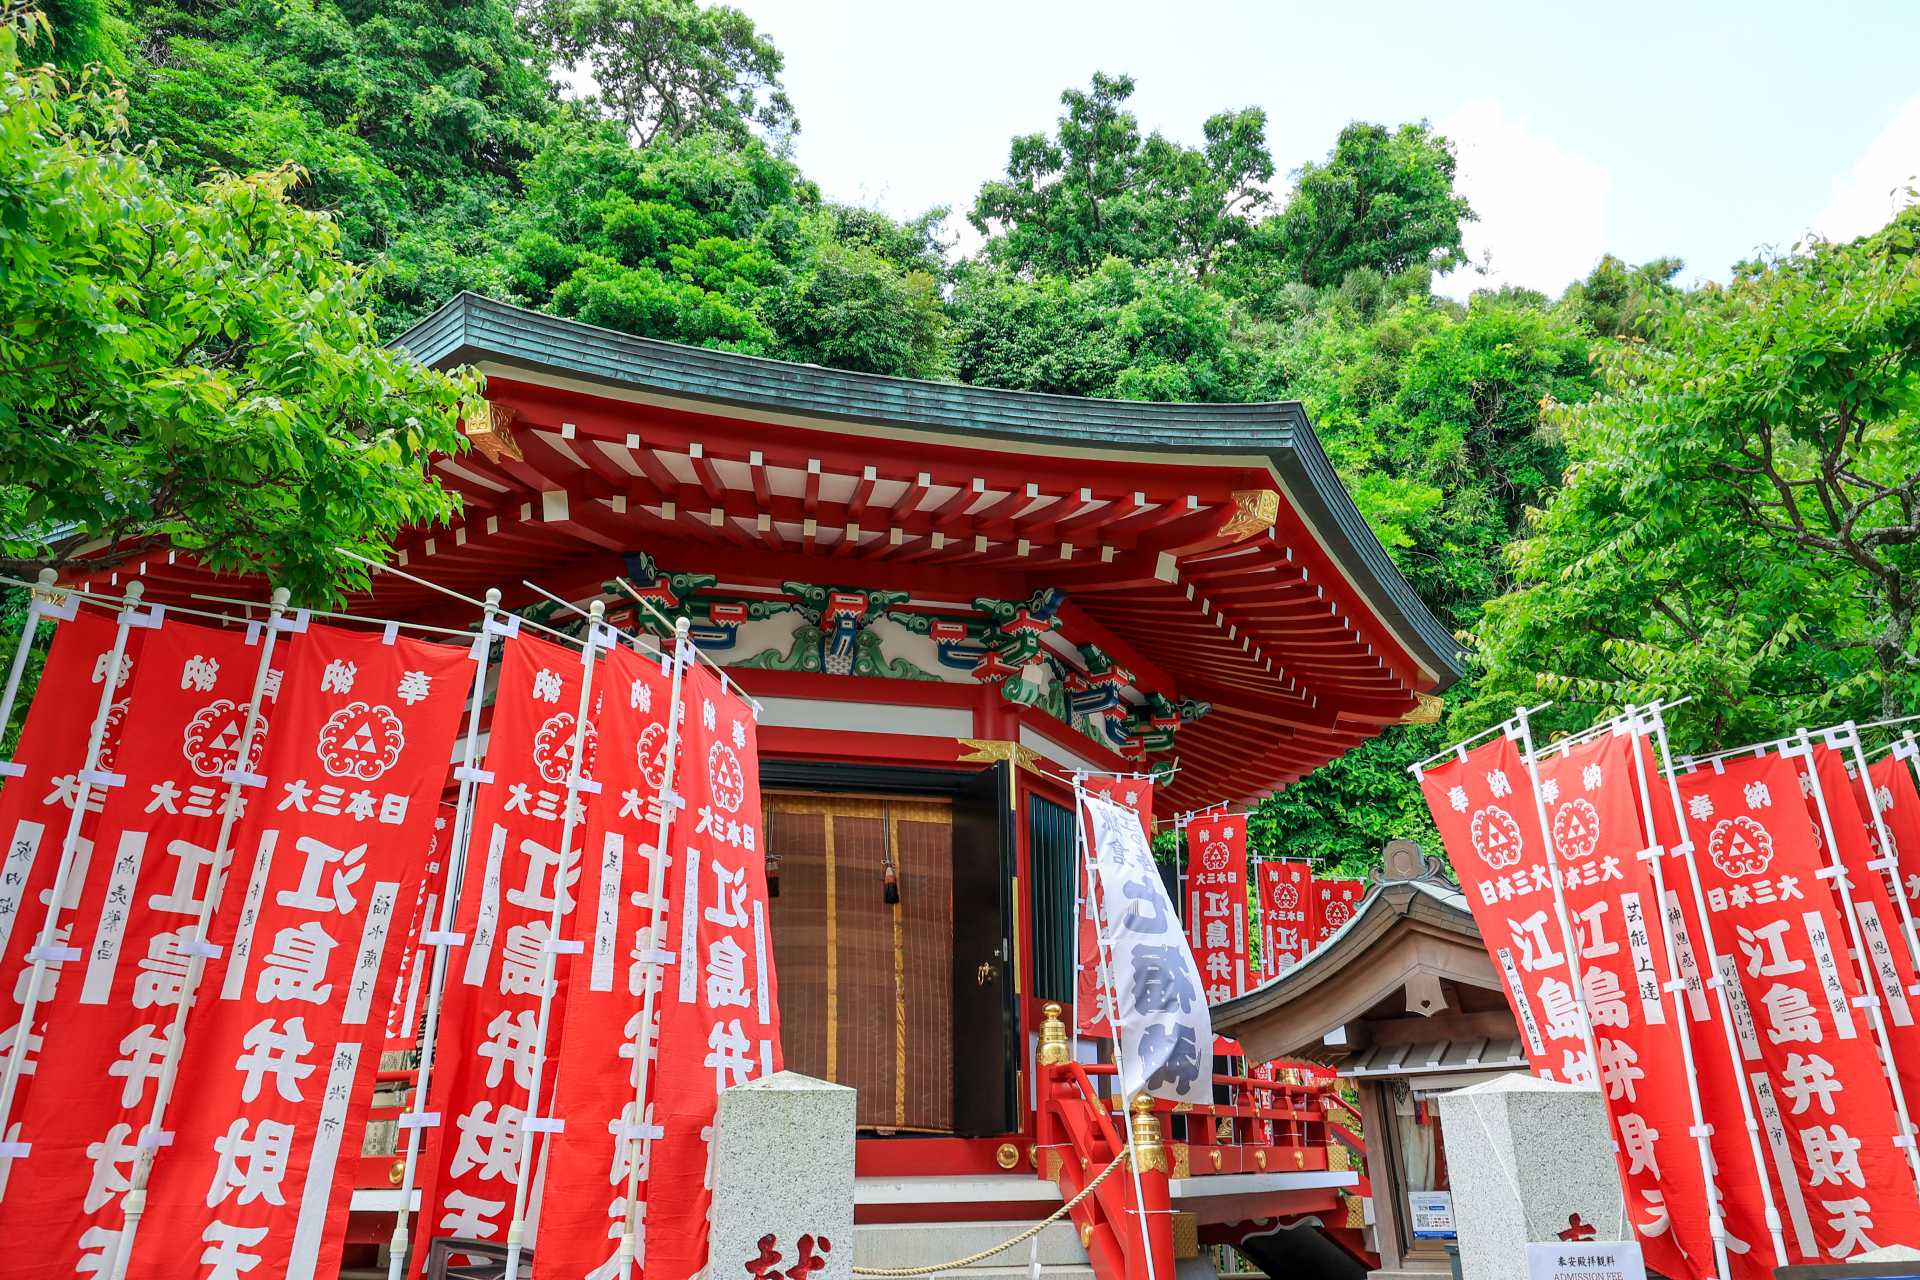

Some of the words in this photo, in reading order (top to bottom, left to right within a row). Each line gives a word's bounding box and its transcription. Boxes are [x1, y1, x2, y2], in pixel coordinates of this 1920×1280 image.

[1478, 863, 1552, 906] 日本三大
[1557, 855, 1624, 891] 本三大
[1707, 875, 1805, 912] 日本三大
[1626, 902, 1660, 1002] 芸能上達
[1737, 919, 1883, 1260] 江島弁財天
[1554, 1272, 1604, 1280] ADMISSION
